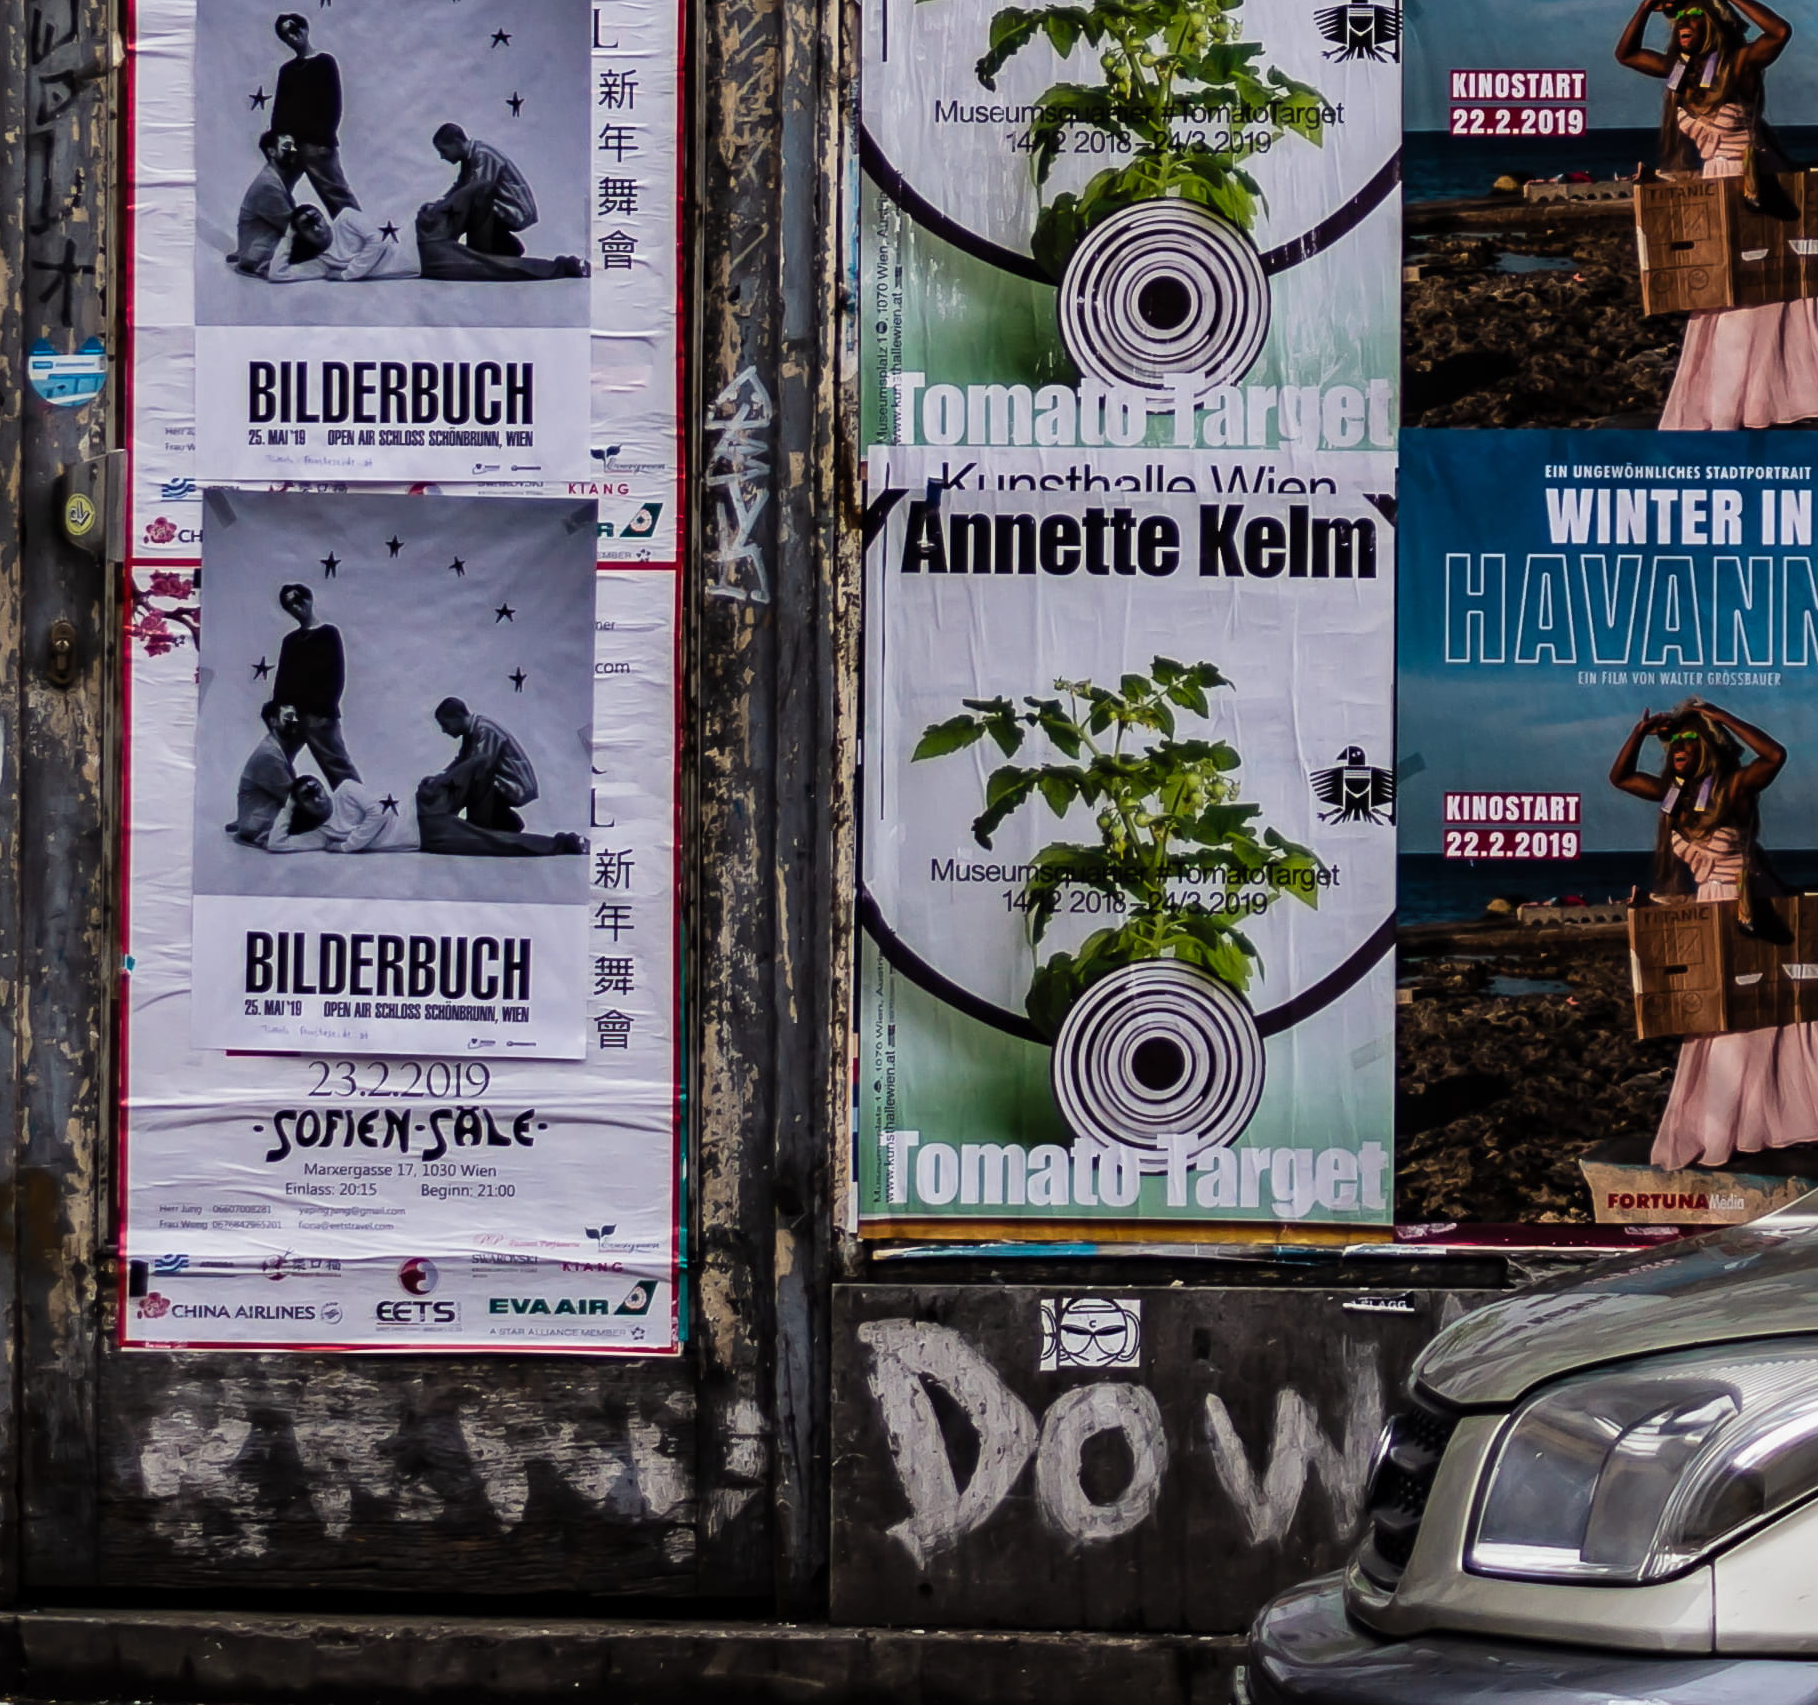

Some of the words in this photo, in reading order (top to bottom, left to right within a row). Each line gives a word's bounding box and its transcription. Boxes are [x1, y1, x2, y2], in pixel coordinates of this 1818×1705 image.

[1451, 72, 1585, 99] KINOSTART
[934, 100, 1153, 129] Museumsquartier
[1451, 109, 1584, 136] 22.2.2019
[1214, 130, 1272, 155] 2019
[597, 68, 641, 272] 新年舞會
[248, 360, 534, 427] BILDERBUCH
[896, 372, 1148, 447] Tomato
[1162, 372, 1396, 452] Target
[248, 429, 265, 446] 25.
[268, 429, 288, 446] MAI
[327, 430, 355, 446] OPEN
[358, 430, 376, 446] AIR
[379, 431, 425, 447] SCHLOSS
[429, 427, 502, 449] SCHÖNBRUNN,
[506, 431, 534, 448] WIEN
[1544, 465, 1568, 479] EIN
[1572, 462, 1701, 480] UNGEWÖHNLICHES
[1705, 465, 1812, 480] STADTPORTRAIT
[568, 483, 630, 495] KIANG
[1545, 488, 1743, 545] WINTER
[1762, 488, 1813, 545] IN
[901, 501, 1181, 577] Annette
[1199, 503, 1377, 579] Kelm
[1578, 671, 1598, 685] EIN
[1601, 671, 1628, 685] FILM
[1632, 672, 1656, 685] VON
[1660, 672, 1704, 685] WALTER
[1445, 795, 1579, 822] KINOSTART
[1445, 832, 1578, 858] 22.2.2019
[931, 857, 1147, 889] Museumsquartier
[1209, 891, 1269, 916] 2019
[592, 847, 637, 1051] 新年舞會
[244, 930, 532, 1002] BILDERBUCH
[245, 999, 261, 1016] 25.
[264, 1000, 285, 1016] MAI
[323, 1001, 350, 1018] OPEN
[354, 1002, 371, 1018] AIR
[375, 1003, 421, 1020] SCHLOSS
[424, 1001, 498, 1024] SCHÖNBRUNN,
[502, 1006, 529, 1023] WIEN
[307, 1060, 491, 1098] 23.2.2019
[303, 1162, 393, 1180] Marxergasse
[397, 1162, 418, 1179] 17,
[422, 1163, 455, 1177] 1030
[459, 1163, 497, 1177] Wien
[883, 1131, 1141, 1207] Tomato
[1156, 1133, 1389, 1218] Target
[285, 1181, 335, 1197] Einlass:
[339, 1182, 378, 1197] 20:15
[421, 1183, 473, 1200] Beginn:
[477, 1183, 516, 1198] 21:00
[1607, 1193, 1710, 1210] FORTUNA
[1709, 1193, 1745, 1211] Media
[561, 1261, 624, 1273] KIANG
[172, 1304, 231, 1320] CHINA
[235, 1305, 316, 1320] AIRLINES
[376, 1300, 456, 1323] EETS
[489, 1298, 552, 1315] EVA
[554, 1298, 609, 1315] AIR
